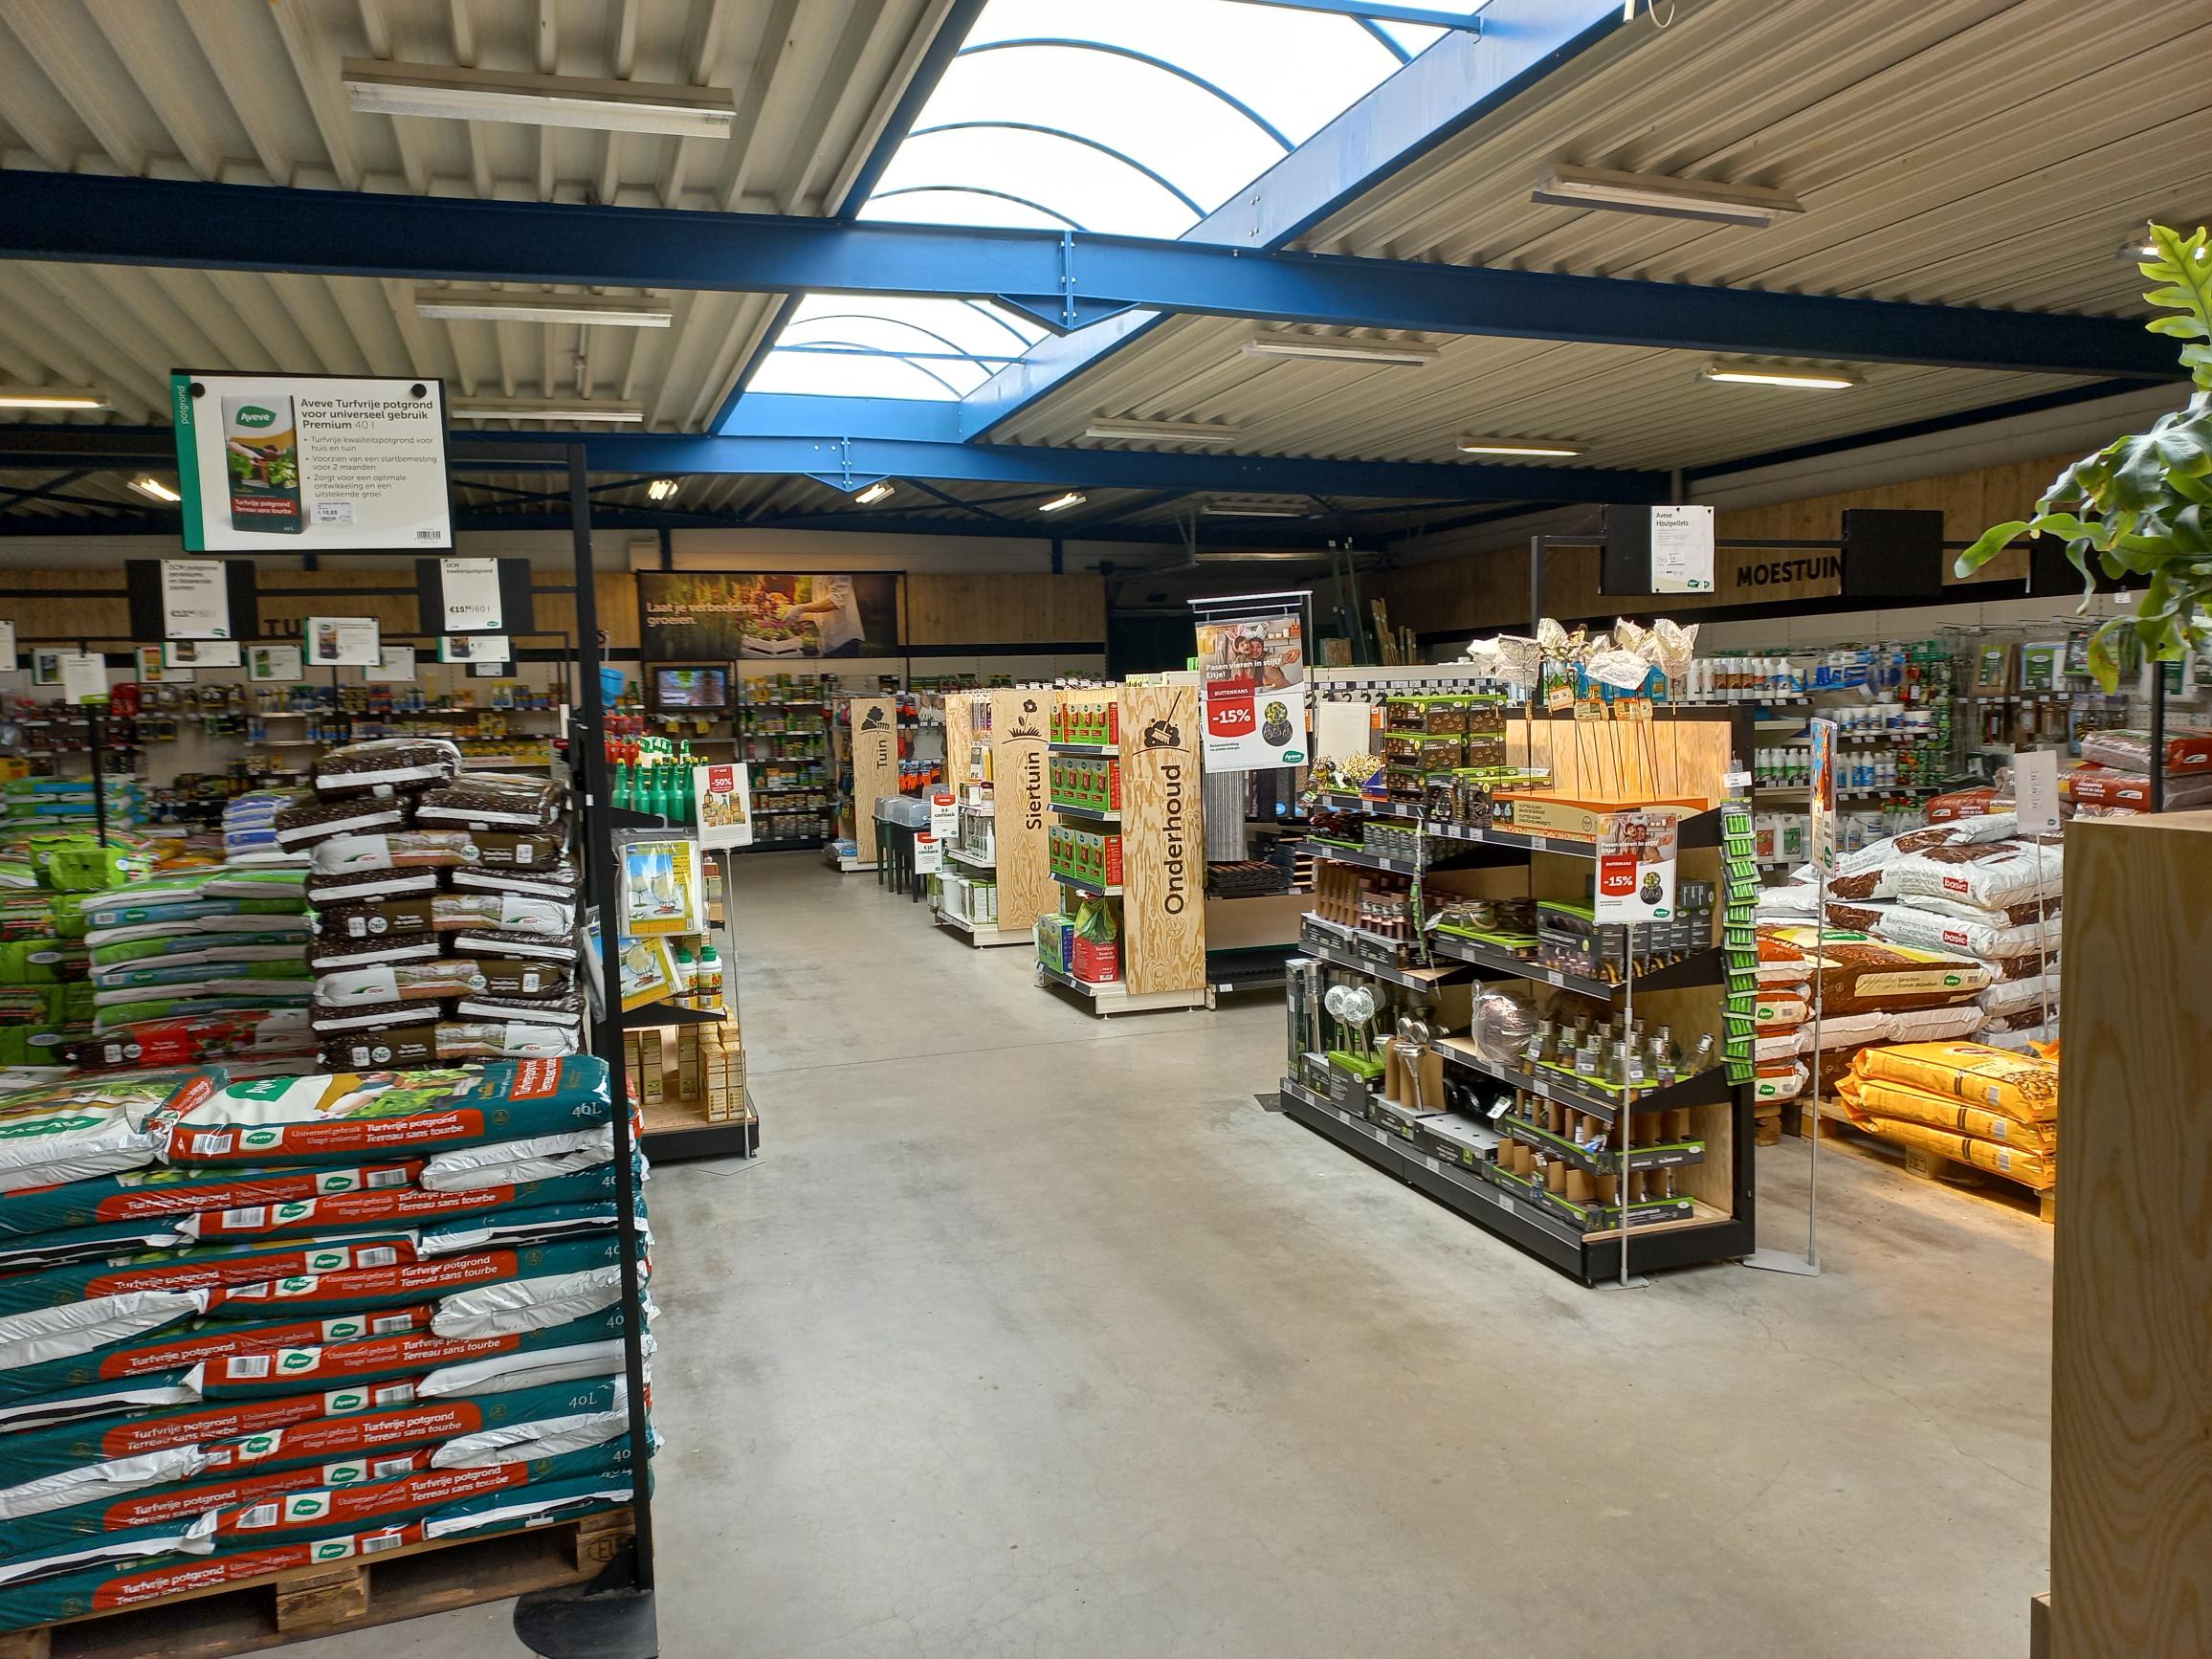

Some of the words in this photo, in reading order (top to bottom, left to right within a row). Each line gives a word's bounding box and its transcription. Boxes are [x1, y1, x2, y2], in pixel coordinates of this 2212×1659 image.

[177, 386, 188, 424] potgrond
[301, 399, 333, 408] Aveve
[335, 400, 381, 409] Turfvrije
[384, 401, 432, 410] potgrond
[241, 413, 270, 422] Aveve
[330, 410, 385, 419] universeel
[387, 411, 428, 421] gebruik
[1737, 556, 1841, 587] MOESTUIN
[647, 602, 674, 612] Laat
[675, 603, 687, 615] je
[647, 615, 697, 628] groeien.
[1263, 658, 1281, 668] stijl?
[1213, 708, 1251, 723] -15%
[876, 740, 888, 769] Tuin
[711, 778, 732, 786] -50%
[1026, 751, 1042, 830] Siertuin
[1161, 764, 1184, 915] Onderhoud
[1604, 876, 1632, 886] -15%
[1944, 878, 1968, 891] basic
[1944, 933, 1967, 944] basic
[331, 1125, 362, 1136] gebruik
[365, 1120, 409, 1133] Turfvrije
[409, 1115, 456, 1128] potgrond
[365, 1131, 405, 1142] Terreau
[406, 1128, 428, 1139] sans
[431, 1123, 464, 1136] tourbe
[397, 1201, 435, 1212] Terreau
[436, 1198, 459, 1209] sans
[461, 1192, 498, 1206] tourbe
[400, 1264, 442, 1278] Turfvrije
[443, 1255, 491, 1271] potgrond
[439, 1272, 462, 1284] sans
[463, 1264, 498, 1280] tourbe
[115, 1277, 164, 1290] Turfvrije
[166, 1271, 219, 1284] potgrond
[129, 1354, 179, 1365] Turfvrije
[182, 1342, 236, 1357] potgrond
[403, 1351, 441, 1361] Terreau
[442, 1344, 466, 1356] sans
[467, 1338, 500, 1353] tourbe
[568, 1392, 598, 1408] 40L
[132, 1425, 181, 1439] Turfvrije
[183, 1416, 237, 1431] potgrond
[363, 1420, 405, 1433] Turfvrije
[408, 1411, 455, 1428] potgrond
[363, 1433, 402, 1444] Terreau
[403, 1427, 427, 1439] sans
[429, 1421, 462, 1433] tourbe
[410, 1478, 453, 1492] Turfvrije
[454, 1465, 501, 1485] potgrond
[132, 1502, 182, 1515] Turfvrije
[183, 1490, 236, 1506] potgrond
[411, 1490, 450, 1502] Terreau
[451, 1484, 474, 1497] sans
[122, 1581, 169, 1594] Turfvrije
[171, 1565, 225, 1585] potgrond
